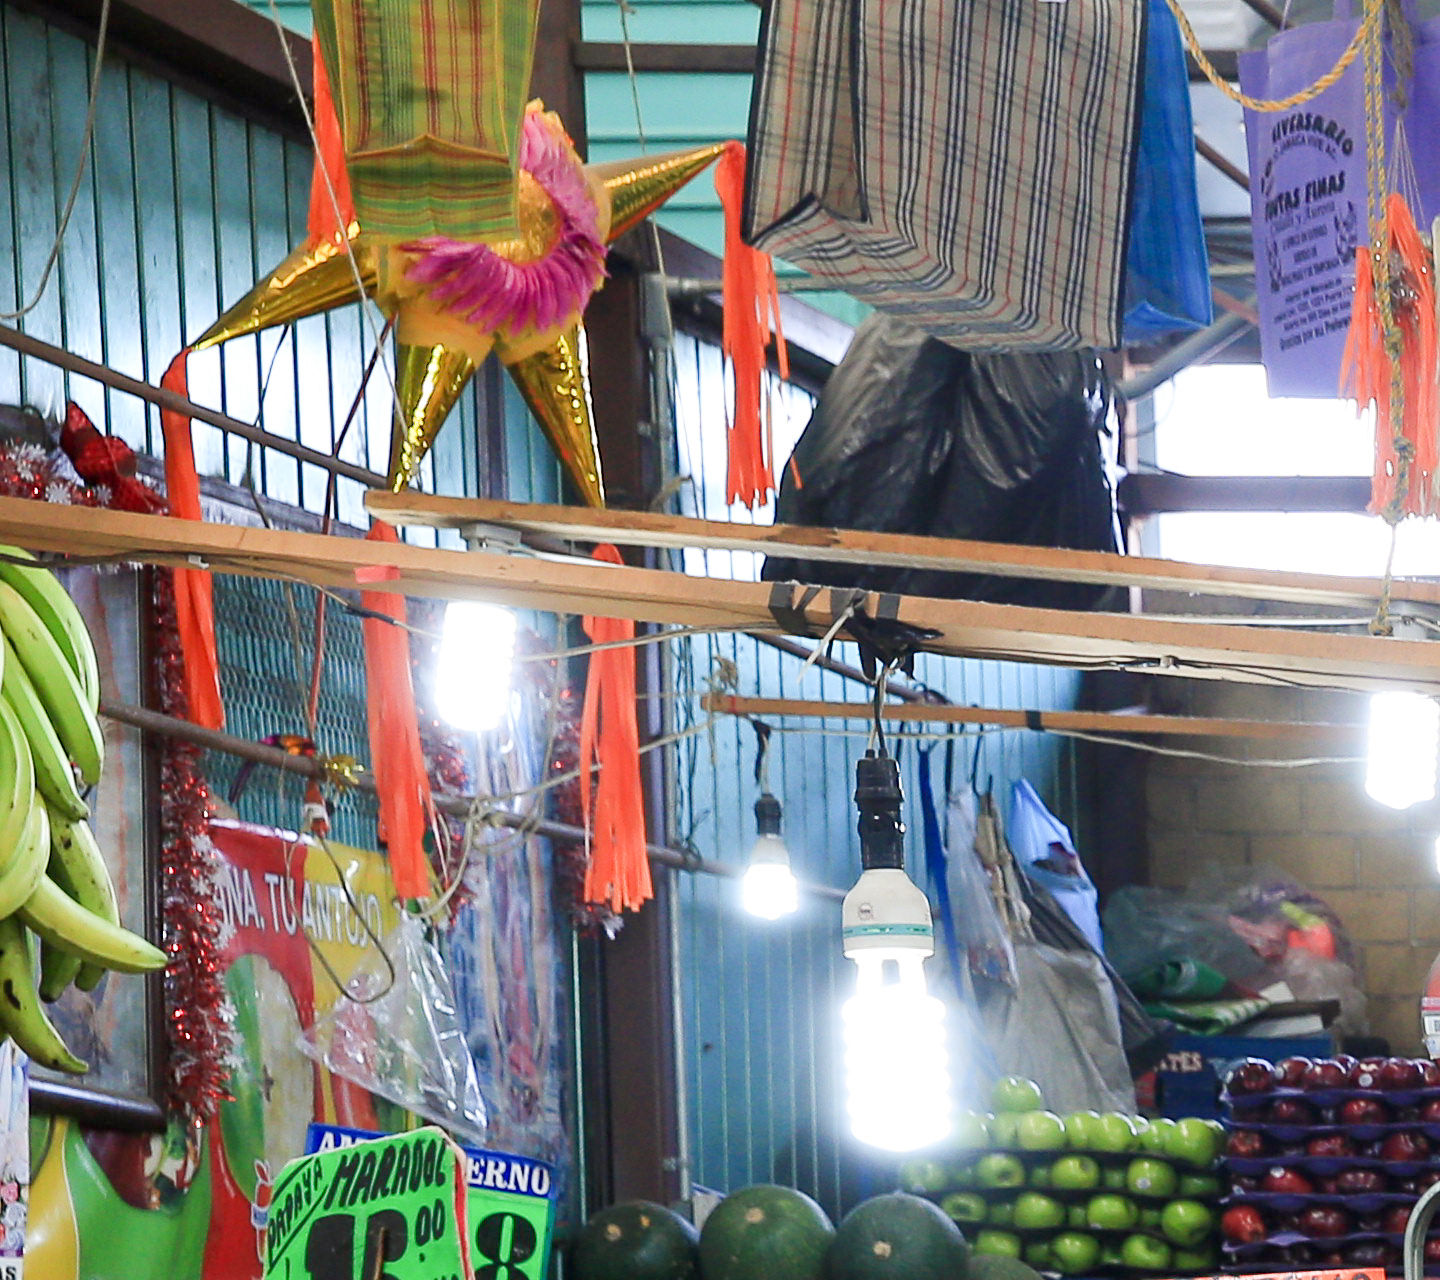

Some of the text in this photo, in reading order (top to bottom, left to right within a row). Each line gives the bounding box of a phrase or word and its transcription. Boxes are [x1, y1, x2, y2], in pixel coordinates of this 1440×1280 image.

[267, 1137, 448, 1251] PAPAYA MARADOL
[466, 1155, 551, 1197] ERNO
